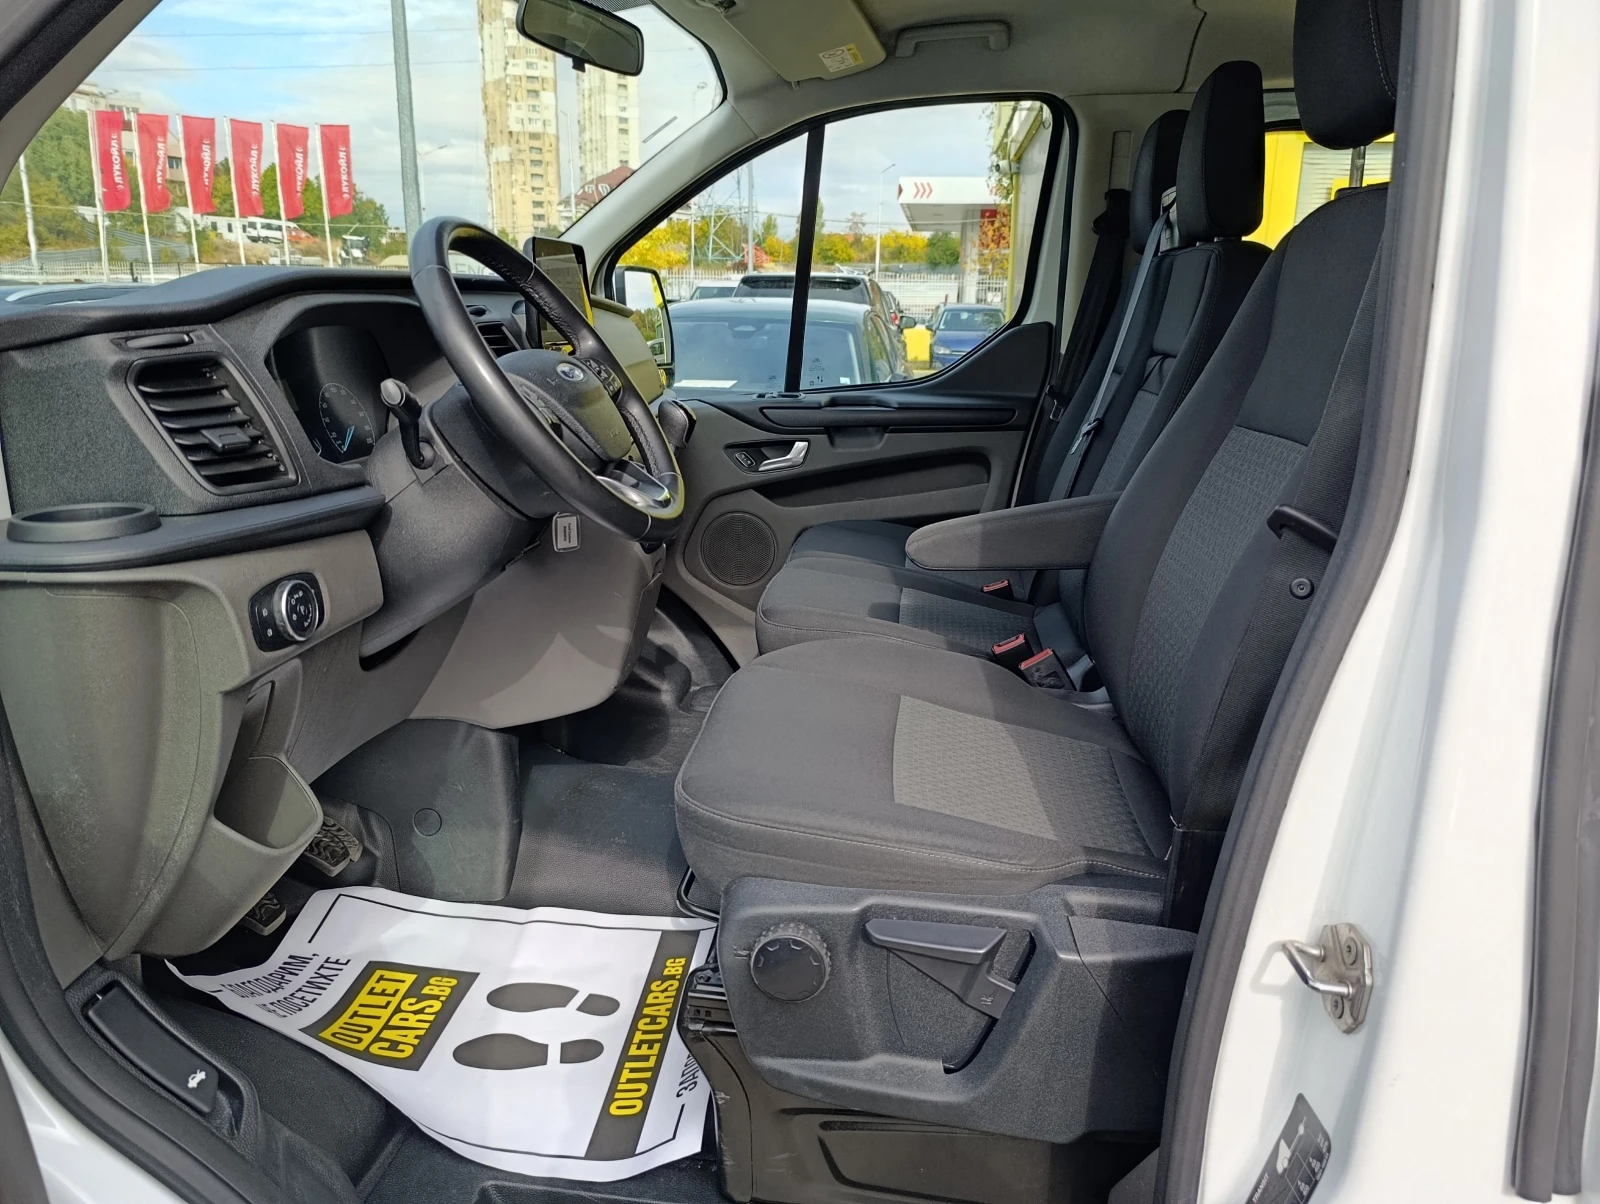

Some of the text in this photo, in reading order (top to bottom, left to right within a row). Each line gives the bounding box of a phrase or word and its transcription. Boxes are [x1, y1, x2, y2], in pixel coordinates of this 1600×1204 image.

[110, 139, 123, 185] ЛУКОЙЛ
[249, 149, 259, 192] ЛУКОЙЛ
[338, 151, 350, 194] ЛУКОЙЛ
[268, 956, 352, 1016] ПОСЕТИХТЕ
[330, 974, 407, 1046] OUTLET
[368, 976, 459, 1060] CARS.BG
[608, 957, 687, 1116] OUTLETCARS.BG
[1251, 1172, 1269, 1203] TRANSIT
